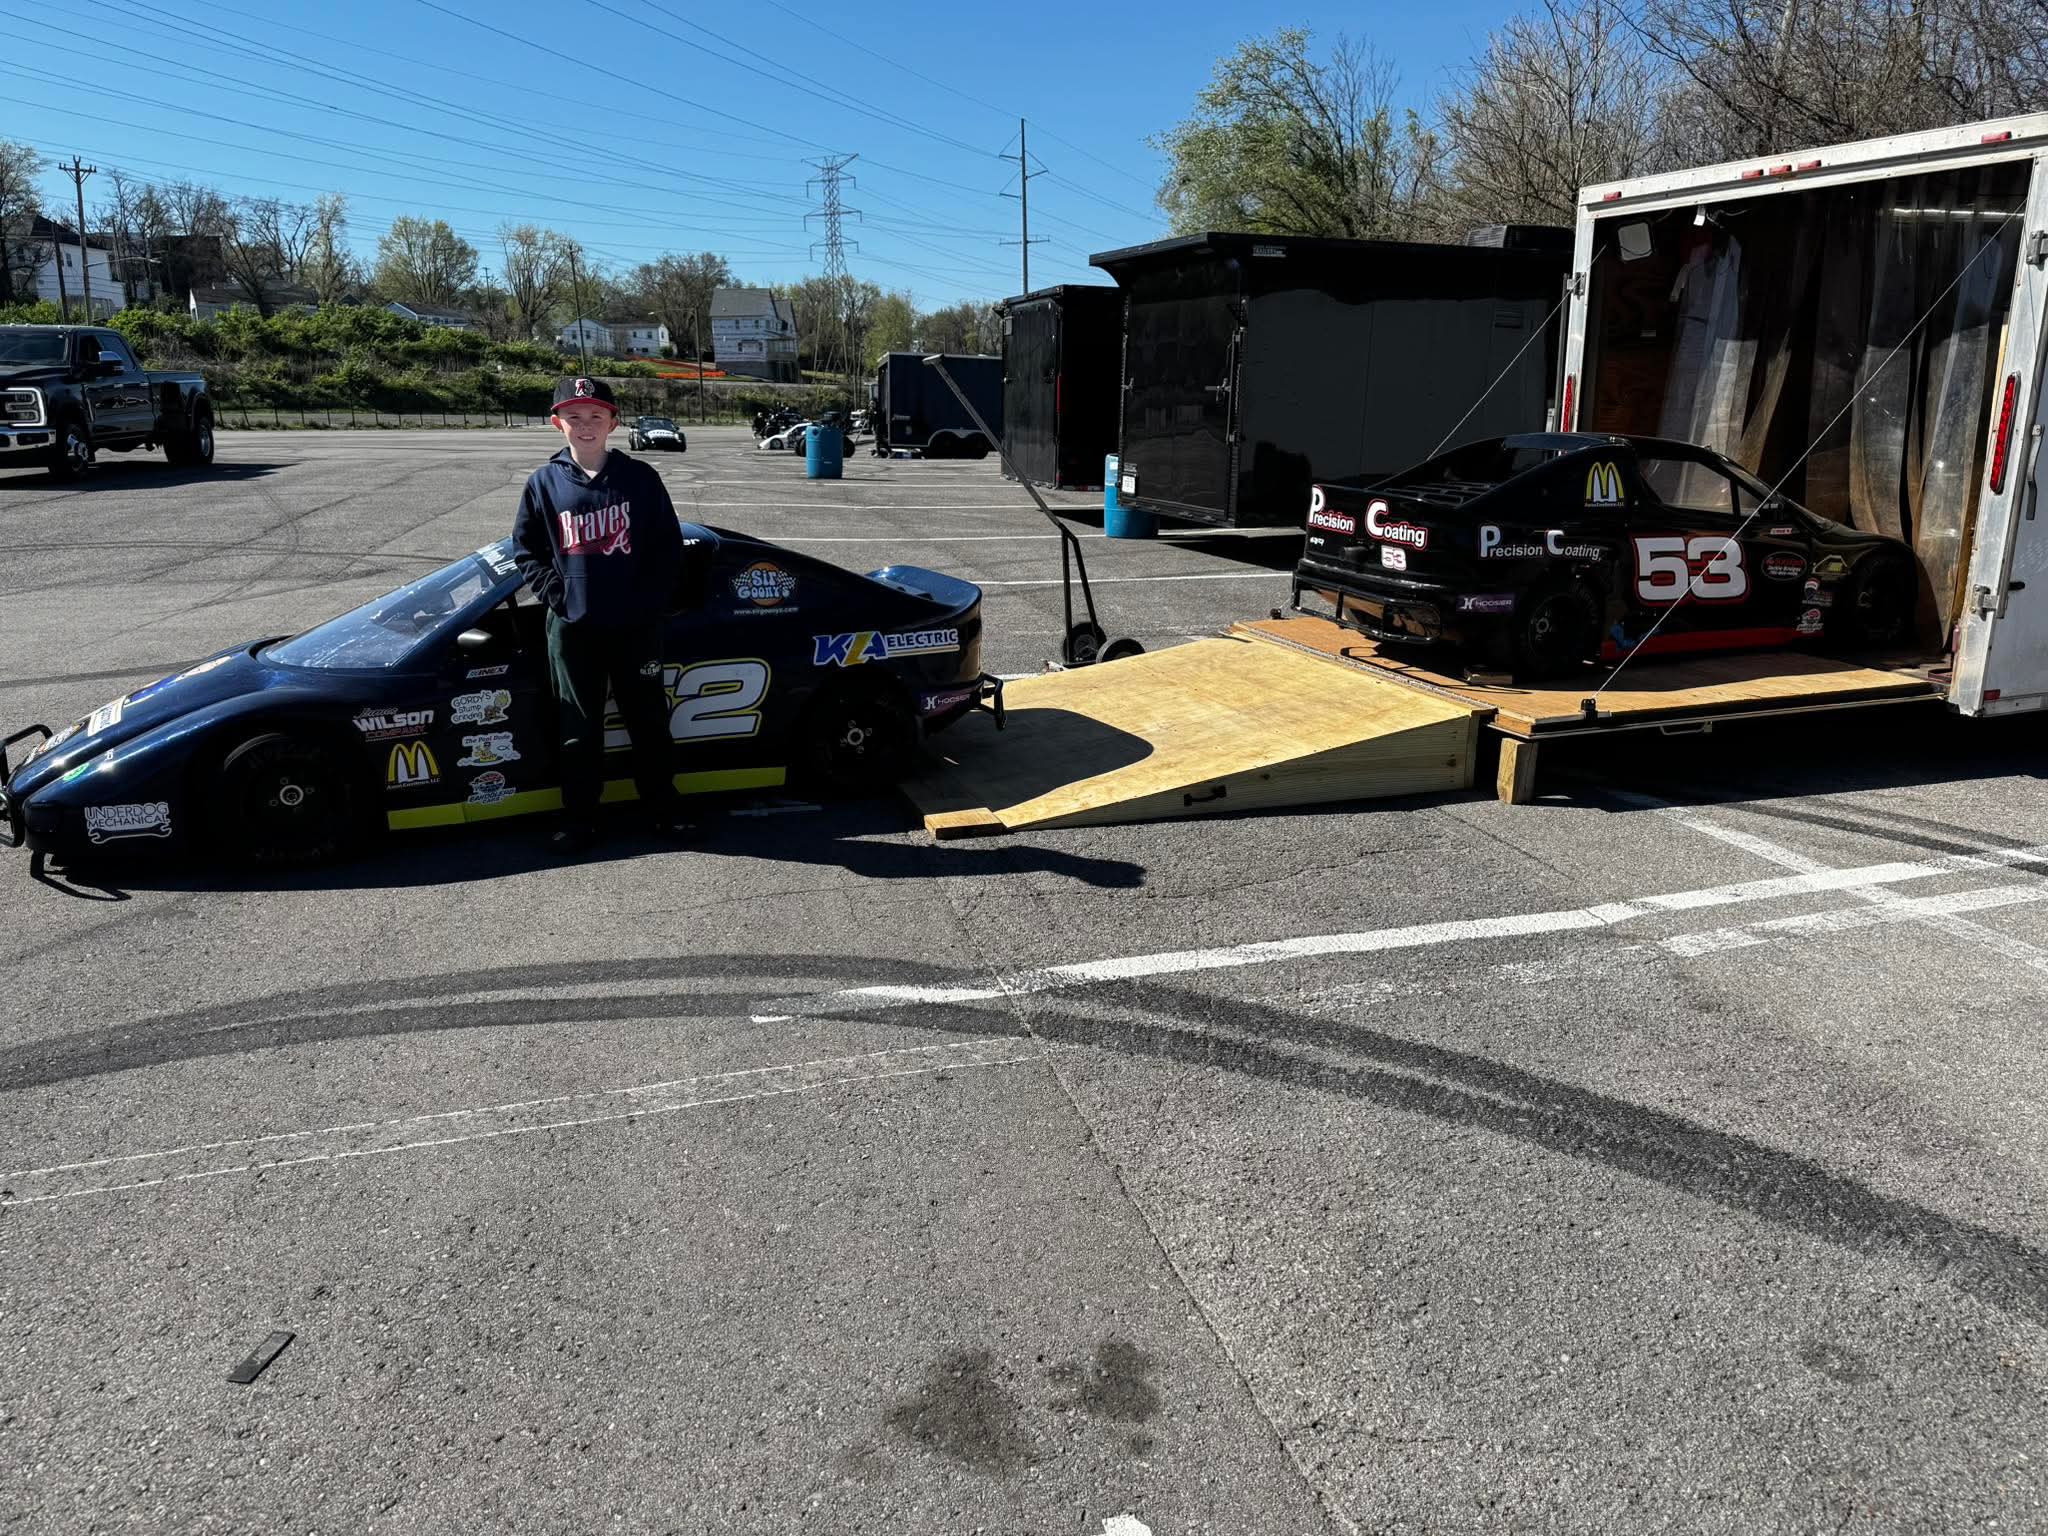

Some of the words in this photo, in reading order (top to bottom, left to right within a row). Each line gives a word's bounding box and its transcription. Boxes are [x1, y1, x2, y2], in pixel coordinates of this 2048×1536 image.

[559, 501, 631, 548] Braves
[1309, 484, 1354, 532] Precision
[1365, 500, 1427, 550] Coating
[603, 529, 631, 555] A
[1480, 525, 1543, 557] Precision
[1547, 530, 1600, 560] Coating
[1381, 545, 1406, 571] 53
[1635, 537, 1746, 600] 53
[752, 570, 777, 586] Sir
[738, 586, 790, 599] GOONY'S
[1475, 599, 1512, 607] HOOSIER
[888, 630, 958, 647] ELECTRIC
[453, 692, 491, 707] GORDY'S
[452, 712, 483, 723] Grinding
[458, 705, 482, 715] Stump
[352, 710, 434, 732] WILSON
[365, 725, 426, 739] COMPANY
[478, 735, 492, 743] Pool
[85, 803, 169, 820] UNDERDOG
[88, 815, 170, 829] MECHANICAL
